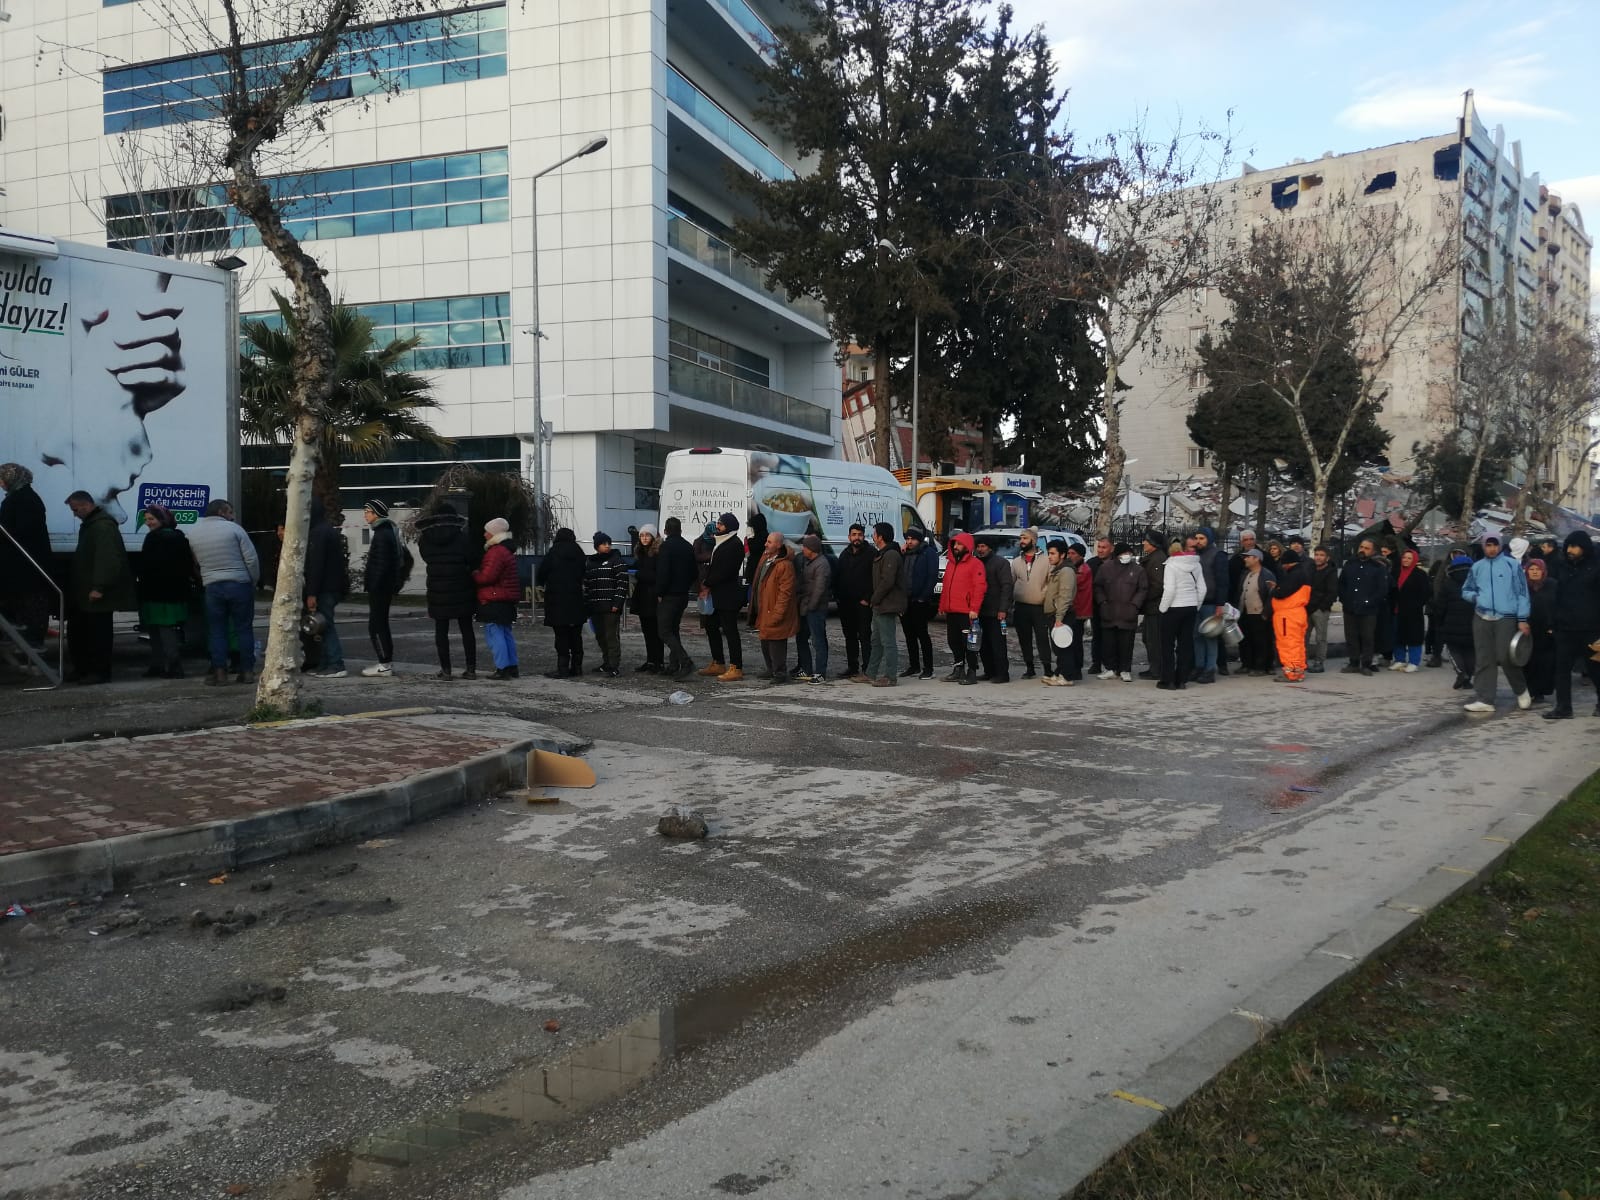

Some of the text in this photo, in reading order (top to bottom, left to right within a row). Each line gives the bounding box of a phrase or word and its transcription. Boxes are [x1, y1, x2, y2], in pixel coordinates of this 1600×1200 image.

[10, 365, 40, 379] GÜLER
[1007, 478, 1030, 488] DenizBank
[144, 486, 206, 499] BÜYÜKŞEHİR
[171, 498, 205, 508] MERKEZİ
